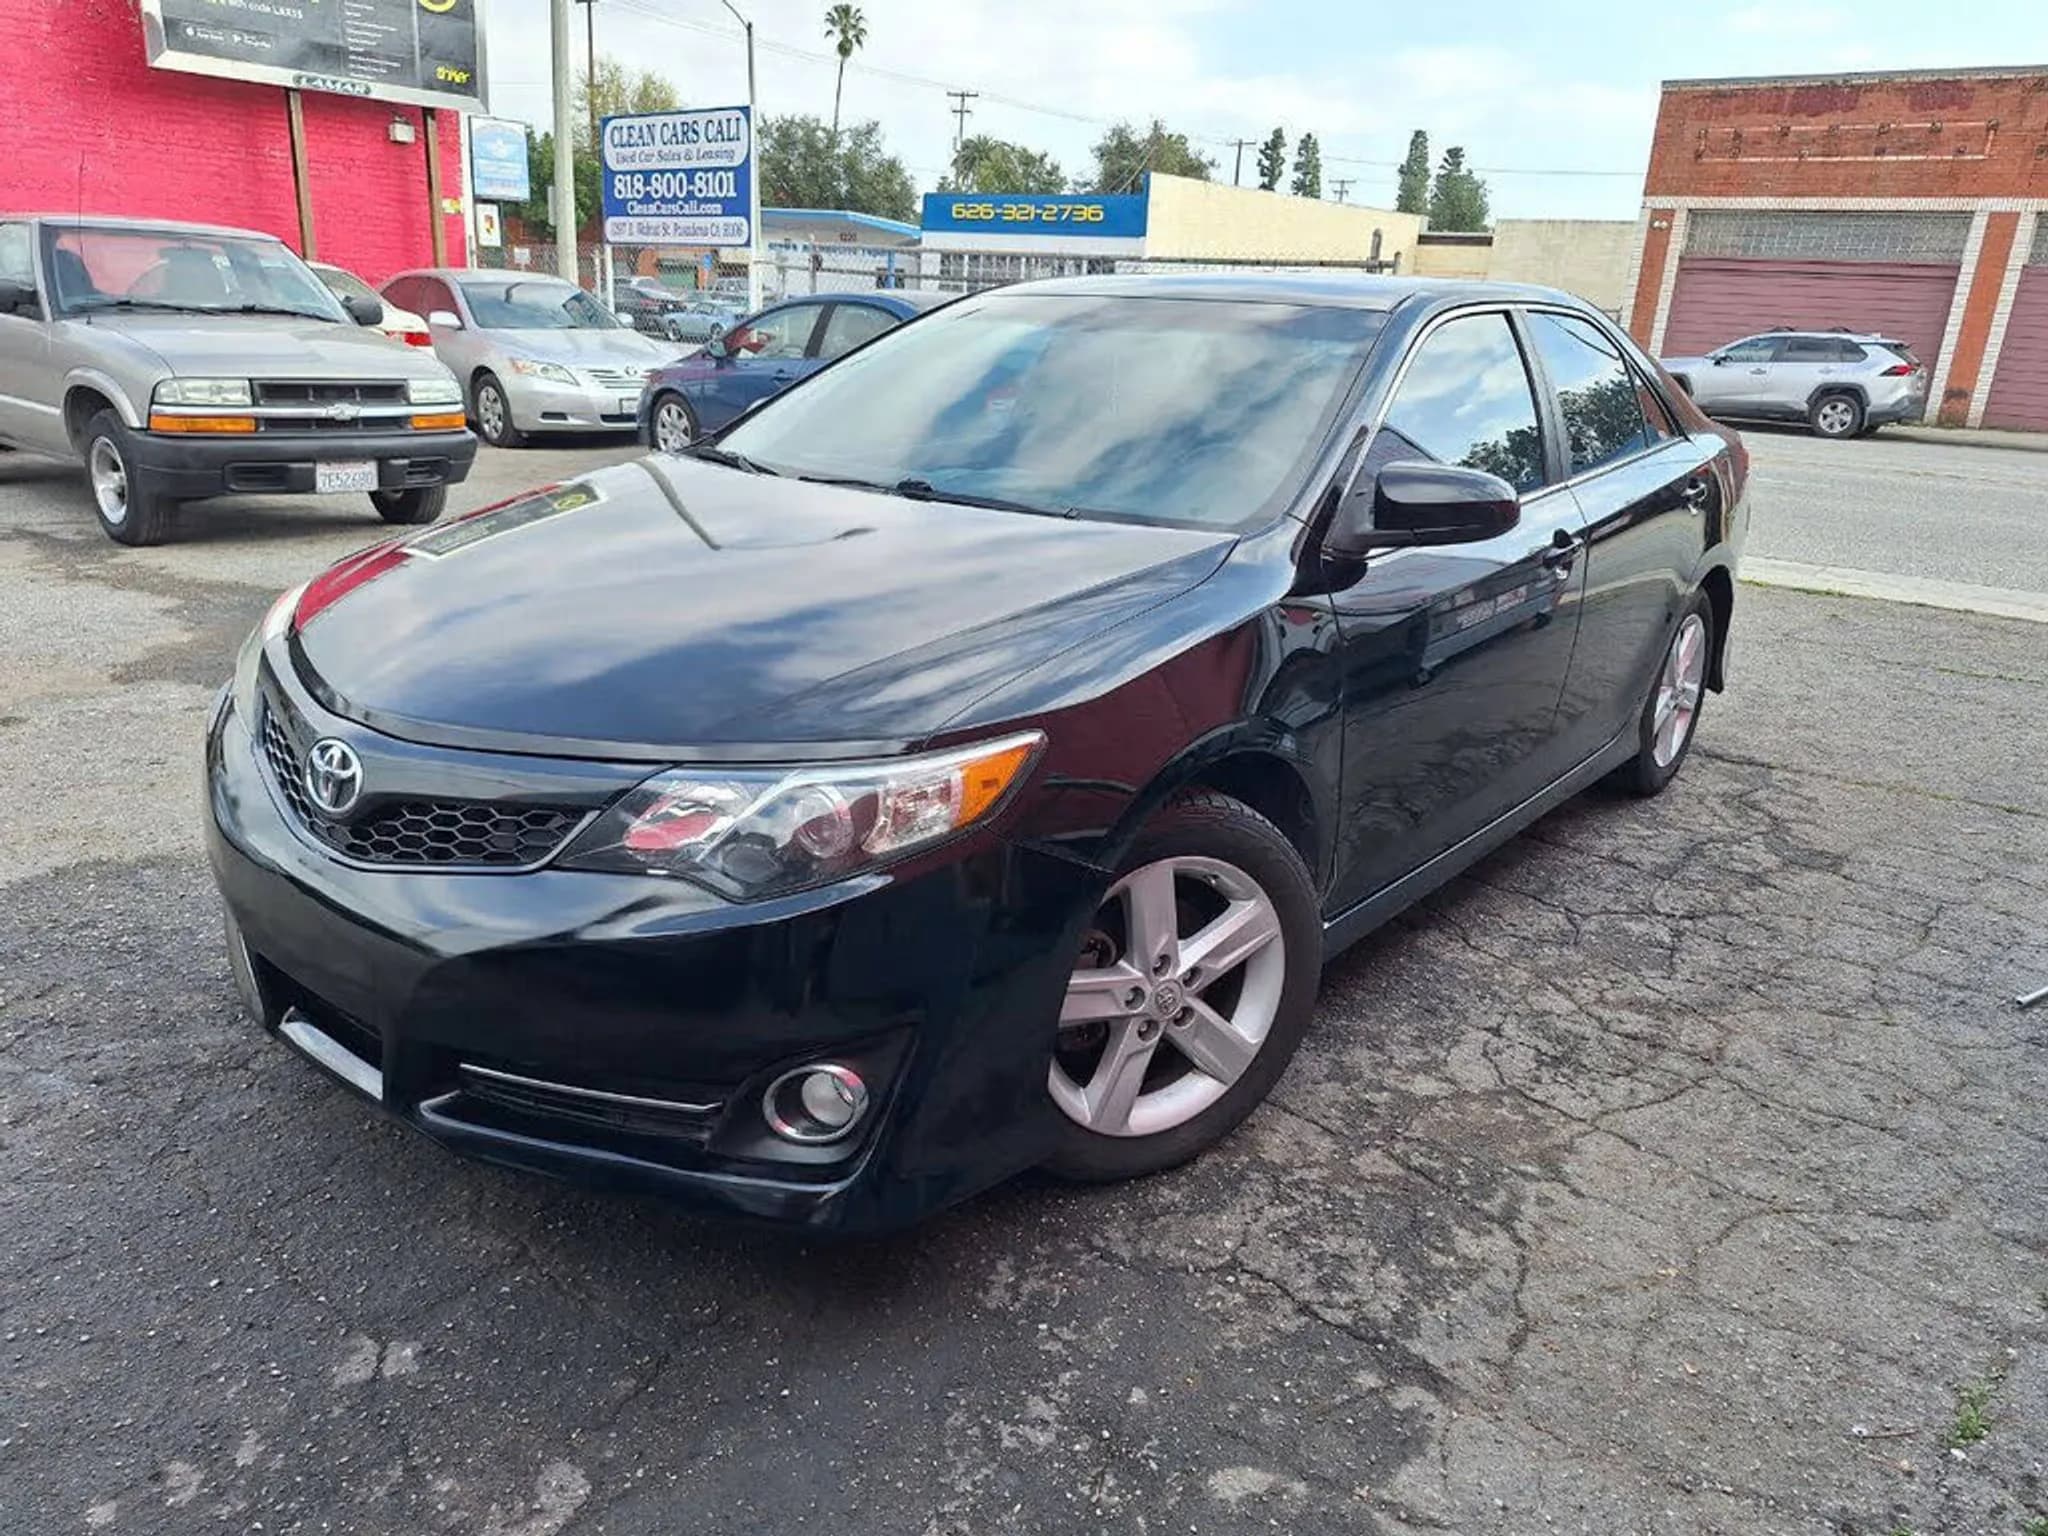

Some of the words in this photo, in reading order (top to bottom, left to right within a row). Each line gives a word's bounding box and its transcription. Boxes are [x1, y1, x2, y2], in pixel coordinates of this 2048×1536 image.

[302, 76, 367, 95] LAMAR
[610, 124, 657, 149] CLEAN
[660, 120, 700, 145] CARS
[704, 117, 742, 143] CALI
[615, 151, 637, 164] Used
[639, 150, 655, 163] Car
[656, 149, 682, 162] Sales
[684, 149, 694, 162] &
[696, 147, 736, 163] Leasing
[613, 170, 738, 199] 818-800-8101
[951, 203, 1105, 222] 626-321-2736
